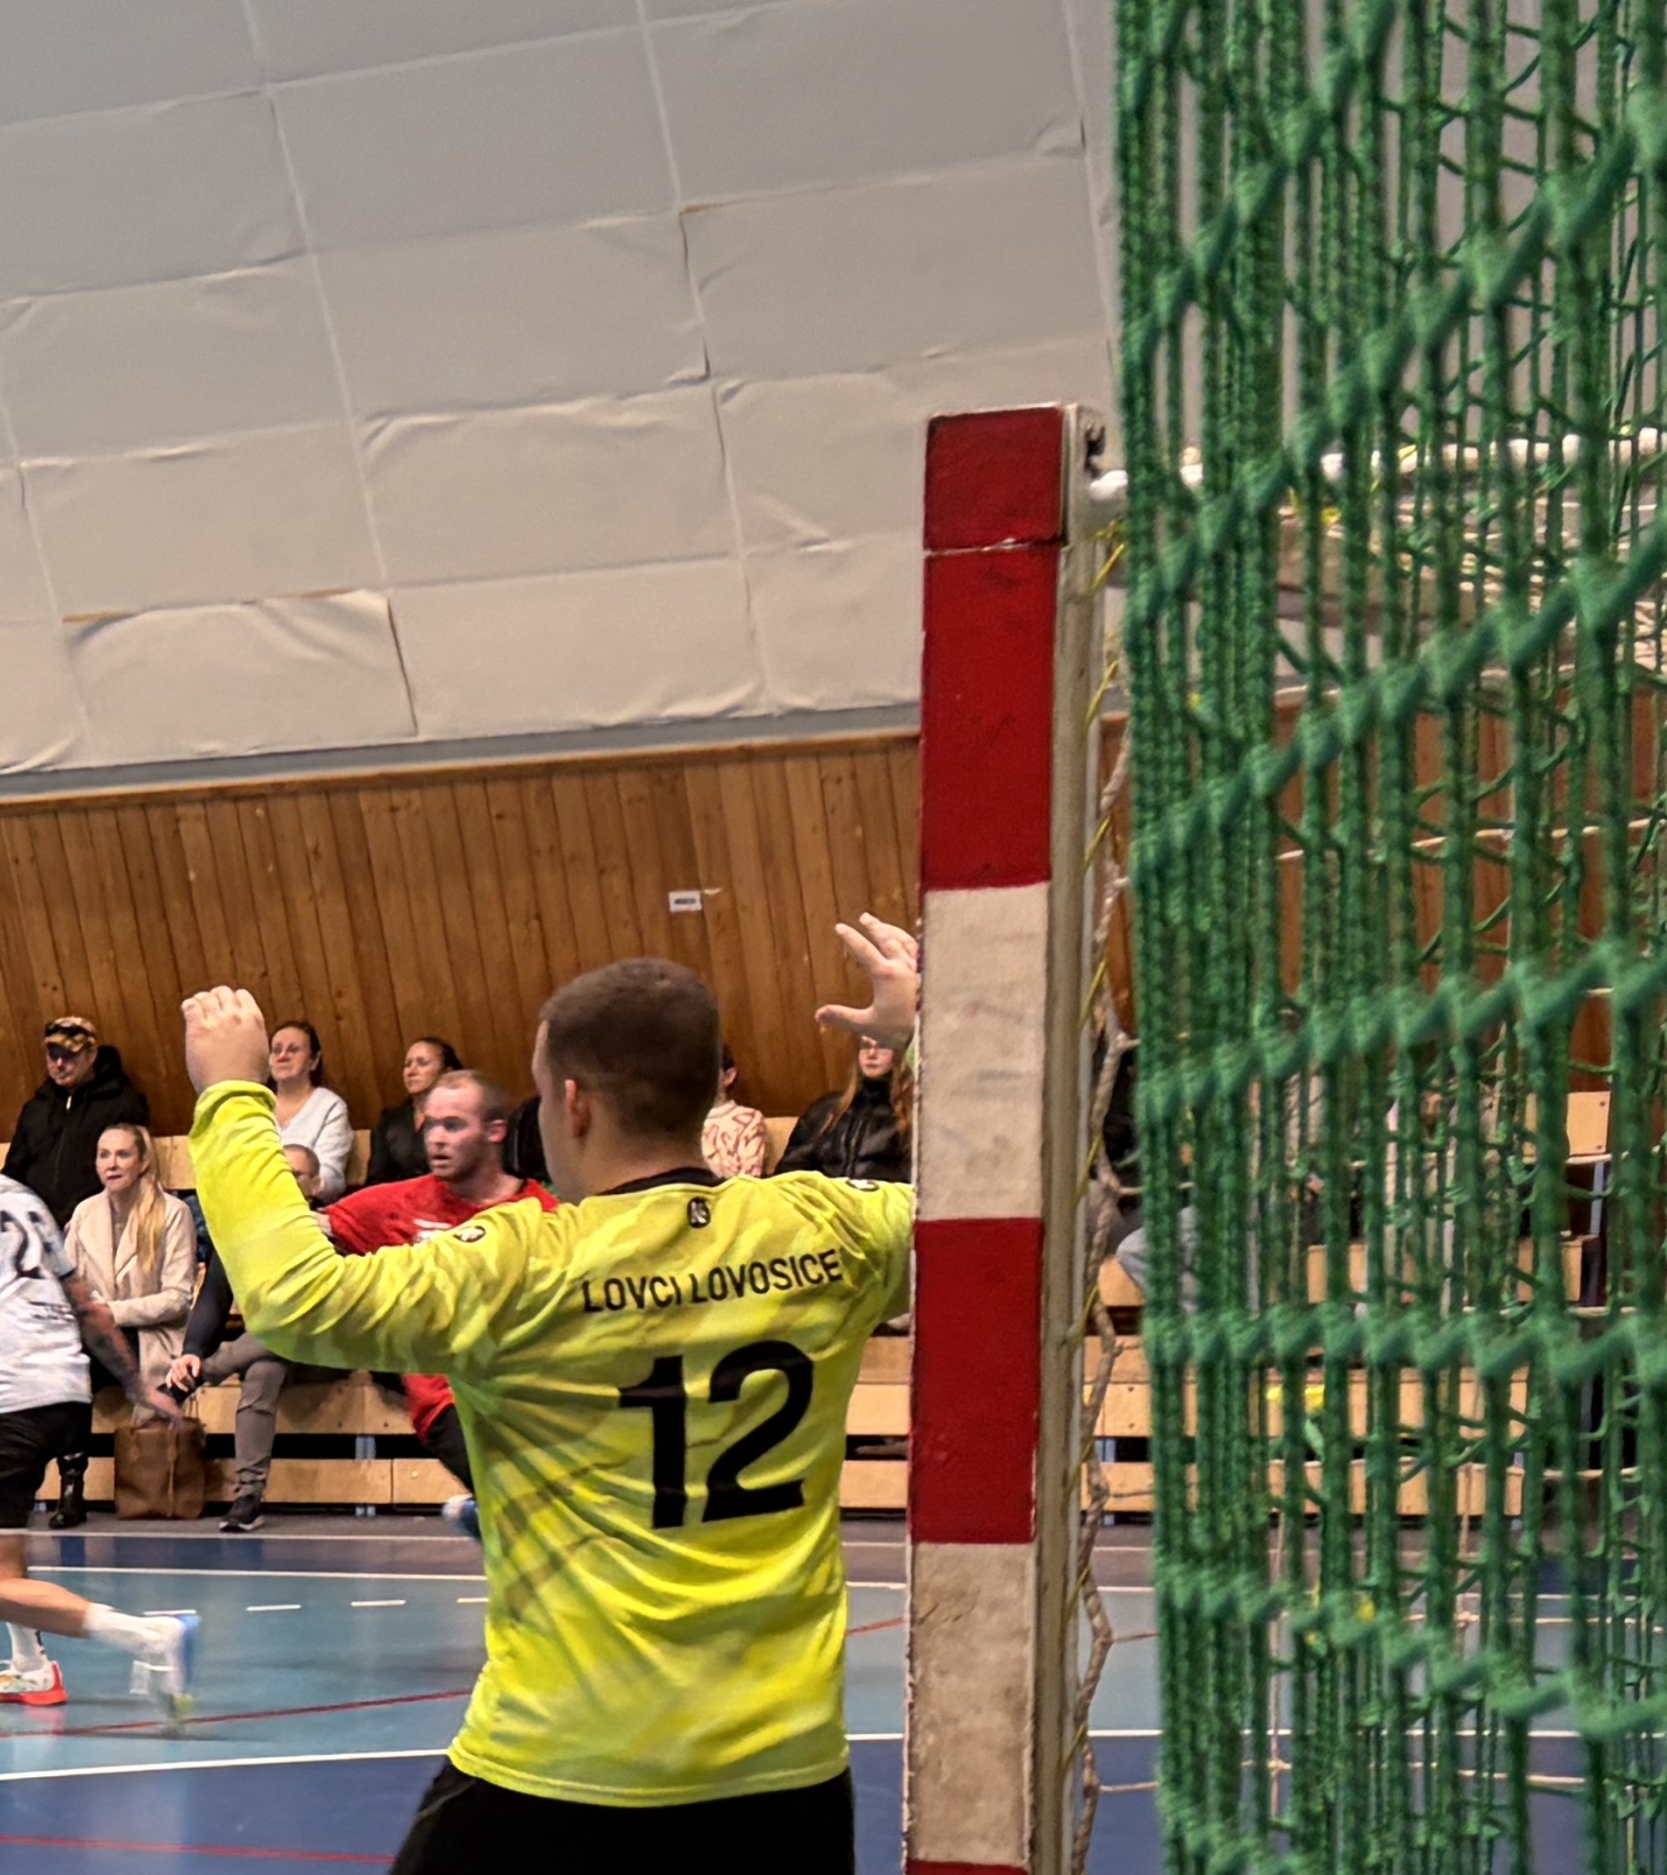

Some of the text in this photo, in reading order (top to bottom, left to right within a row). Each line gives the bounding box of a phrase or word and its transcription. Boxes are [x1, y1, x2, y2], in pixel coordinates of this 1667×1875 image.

[582, 1248, 844, 1314] LOVCI LOVOSICE
[617, 1339, 815, 1530] 12
